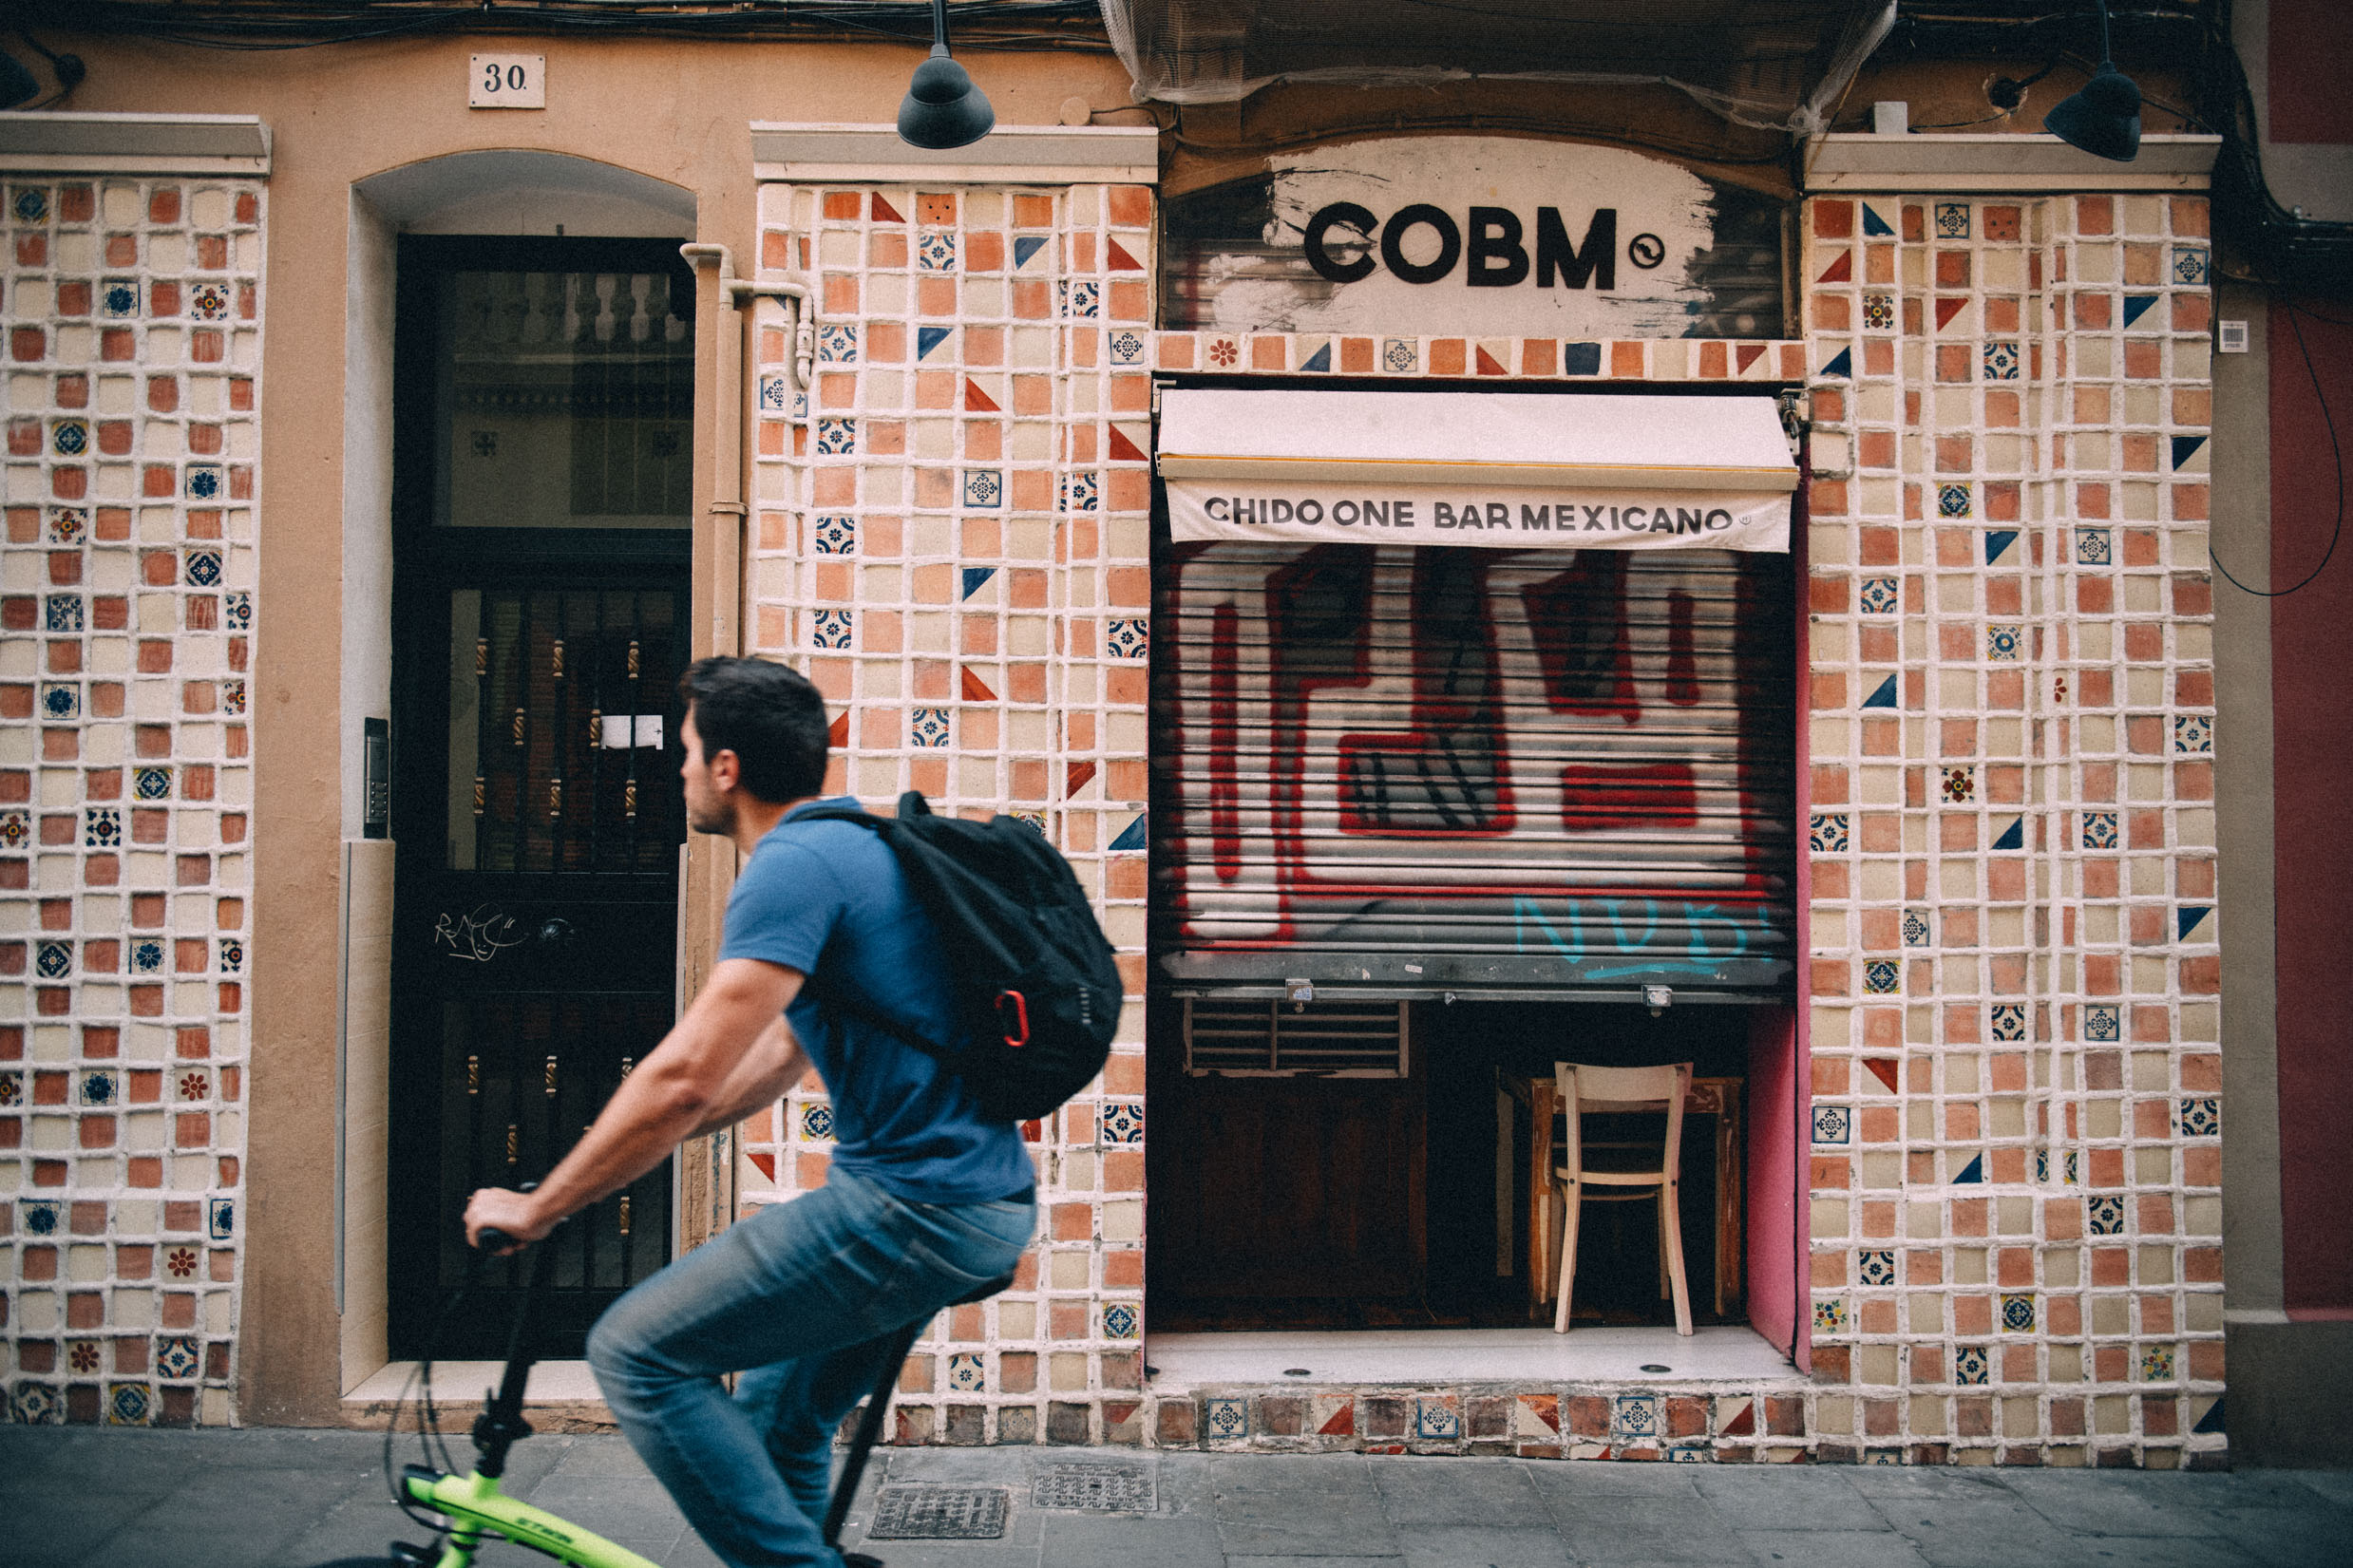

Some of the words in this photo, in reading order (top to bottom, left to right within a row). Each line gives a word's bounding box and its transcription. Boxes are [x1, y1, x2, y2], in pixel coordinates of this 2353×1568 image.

[1303, 200, 1617, 291] COBM
[1204, 497, 1324, 526] CHIDO
[1332, 500, 1414, 528] ONE
[1433, 501, 1512, 530] BAR
[1521, 503, 1734, 536] MEXICANO
